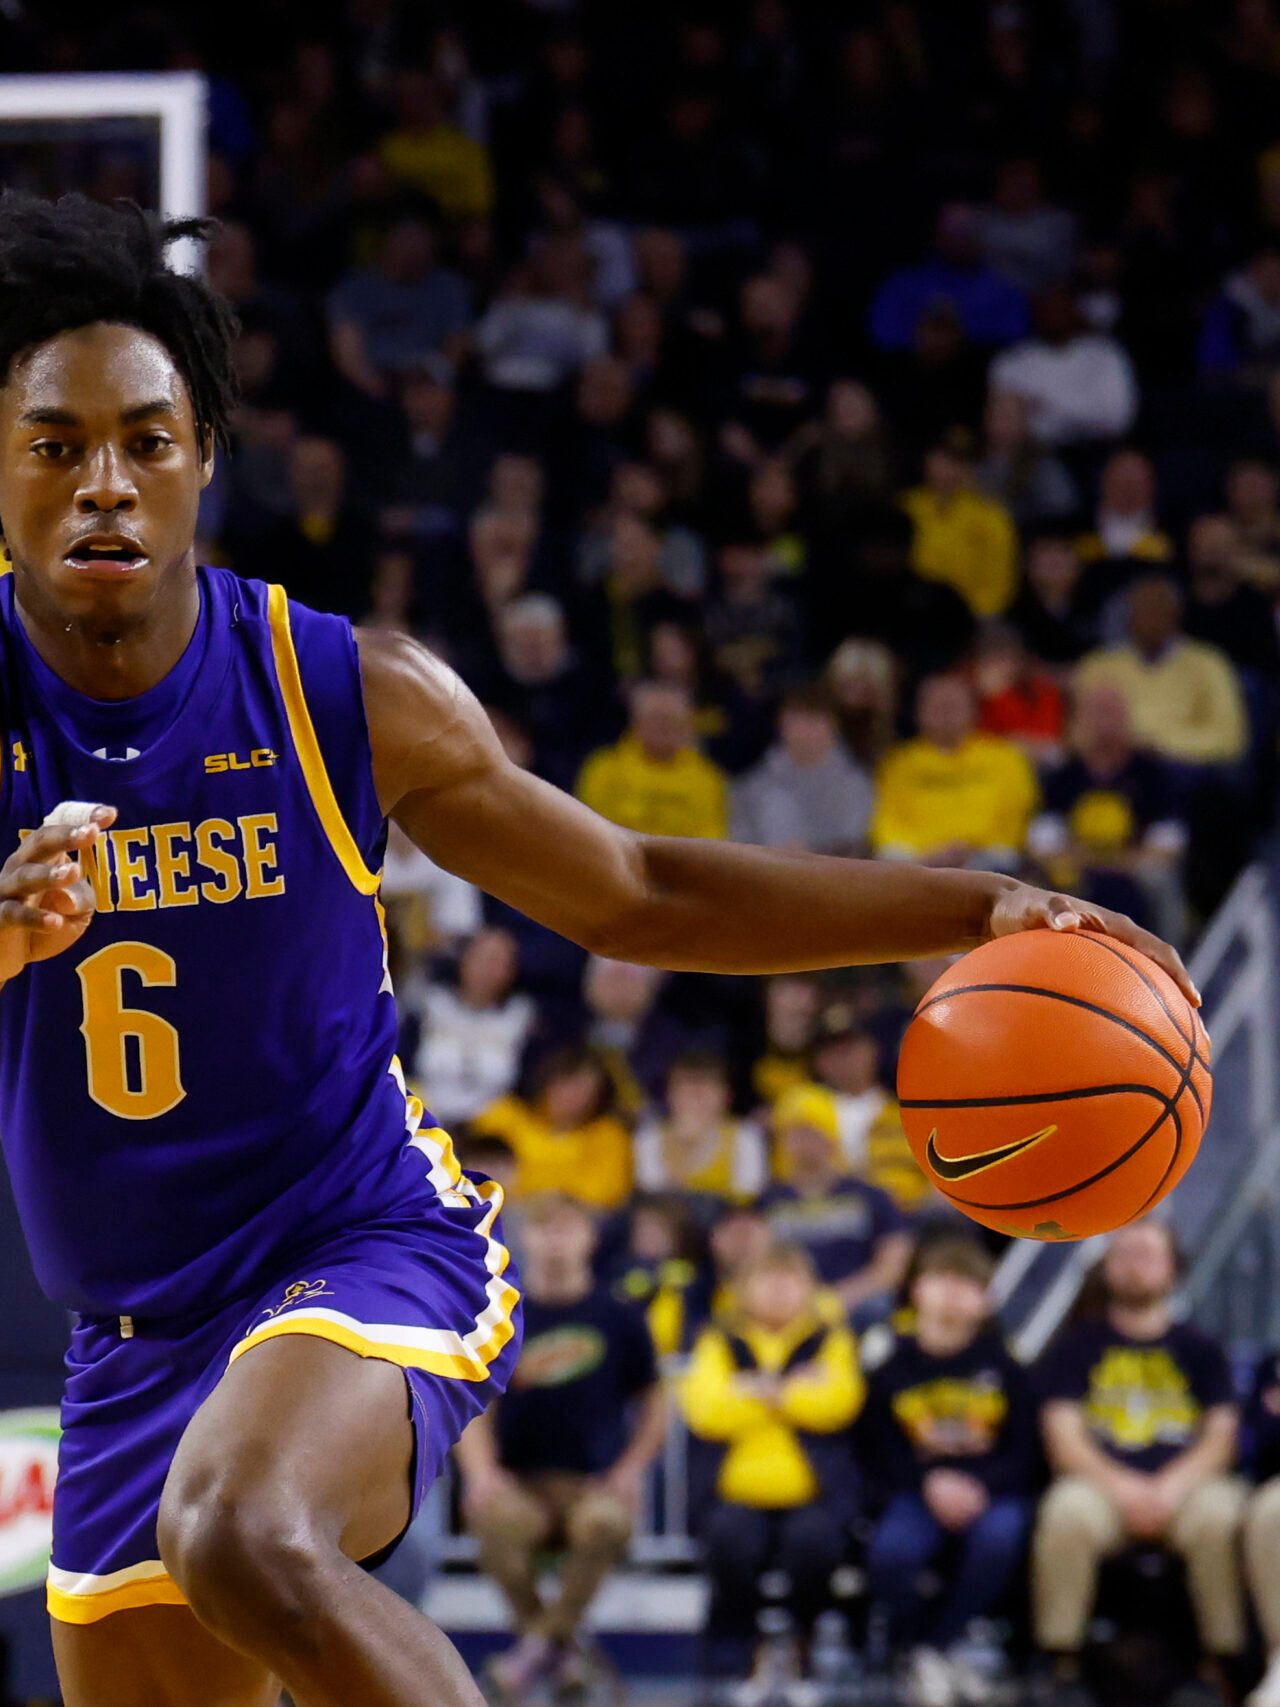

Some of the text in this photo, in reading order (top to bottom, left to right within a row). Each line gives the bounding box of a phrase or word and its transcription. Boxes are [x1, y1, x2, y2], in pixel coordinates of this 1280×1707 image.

[204, 748, 278, 774] SLC
[19, 812, 286, 913] NEESE
[75, 940, 187, 1120] 6
